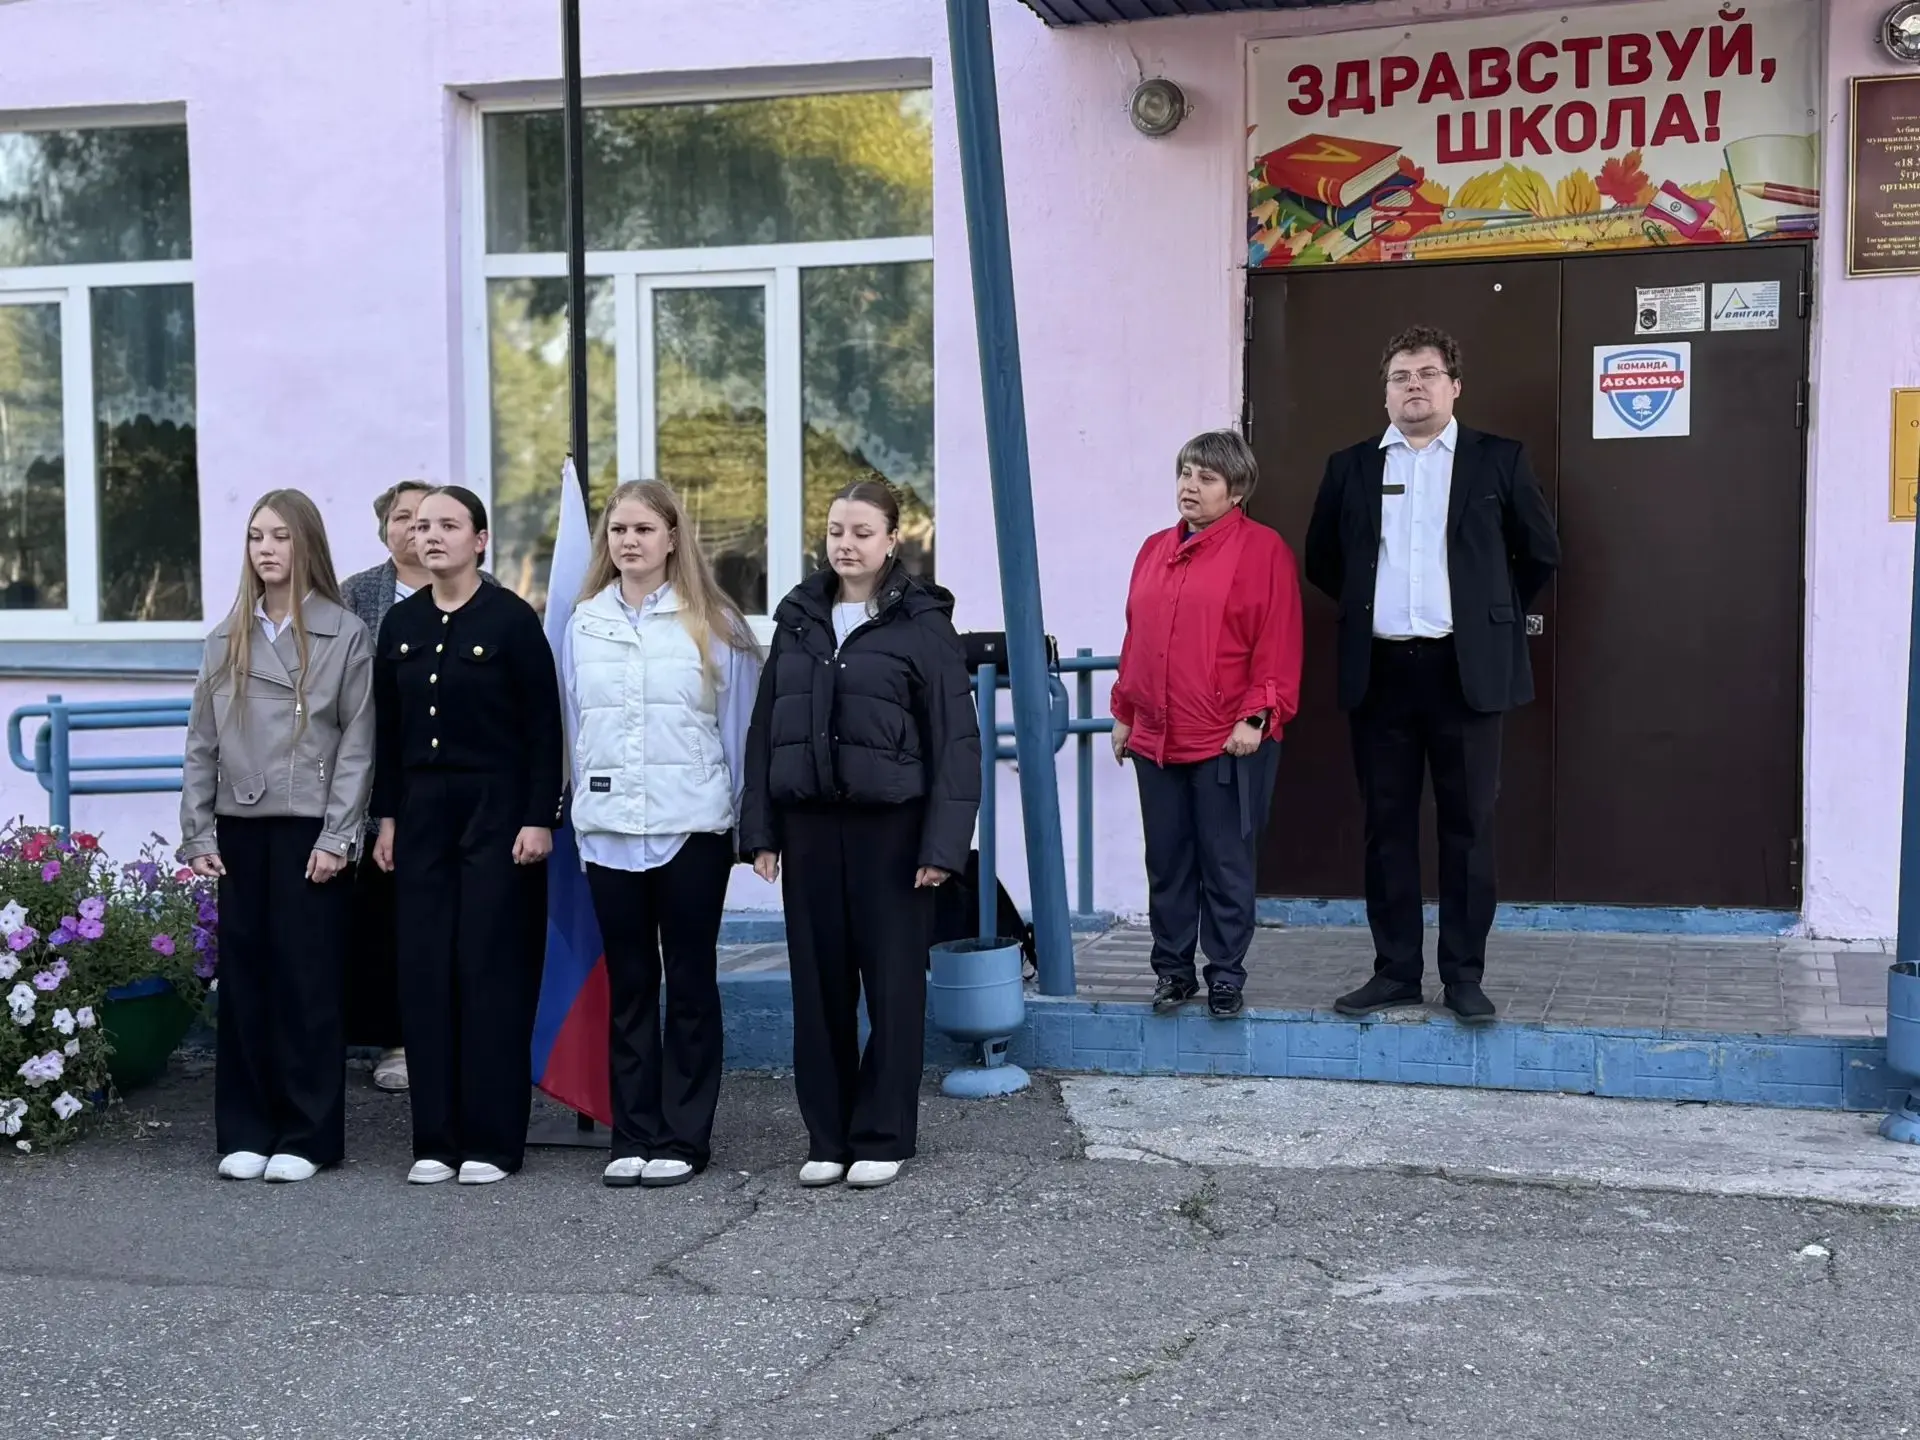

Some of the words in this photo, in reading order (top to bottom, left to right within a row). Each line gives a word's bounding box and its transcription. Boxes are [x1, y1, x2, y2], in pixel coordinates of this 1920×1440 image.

[1287, 8, 1777, 118] ЗДРАВСТВУЙ,
[1436, 90, 1721, 164] ШКОЛА!
[1617, 361, 1668, 370] КОМАНДА
